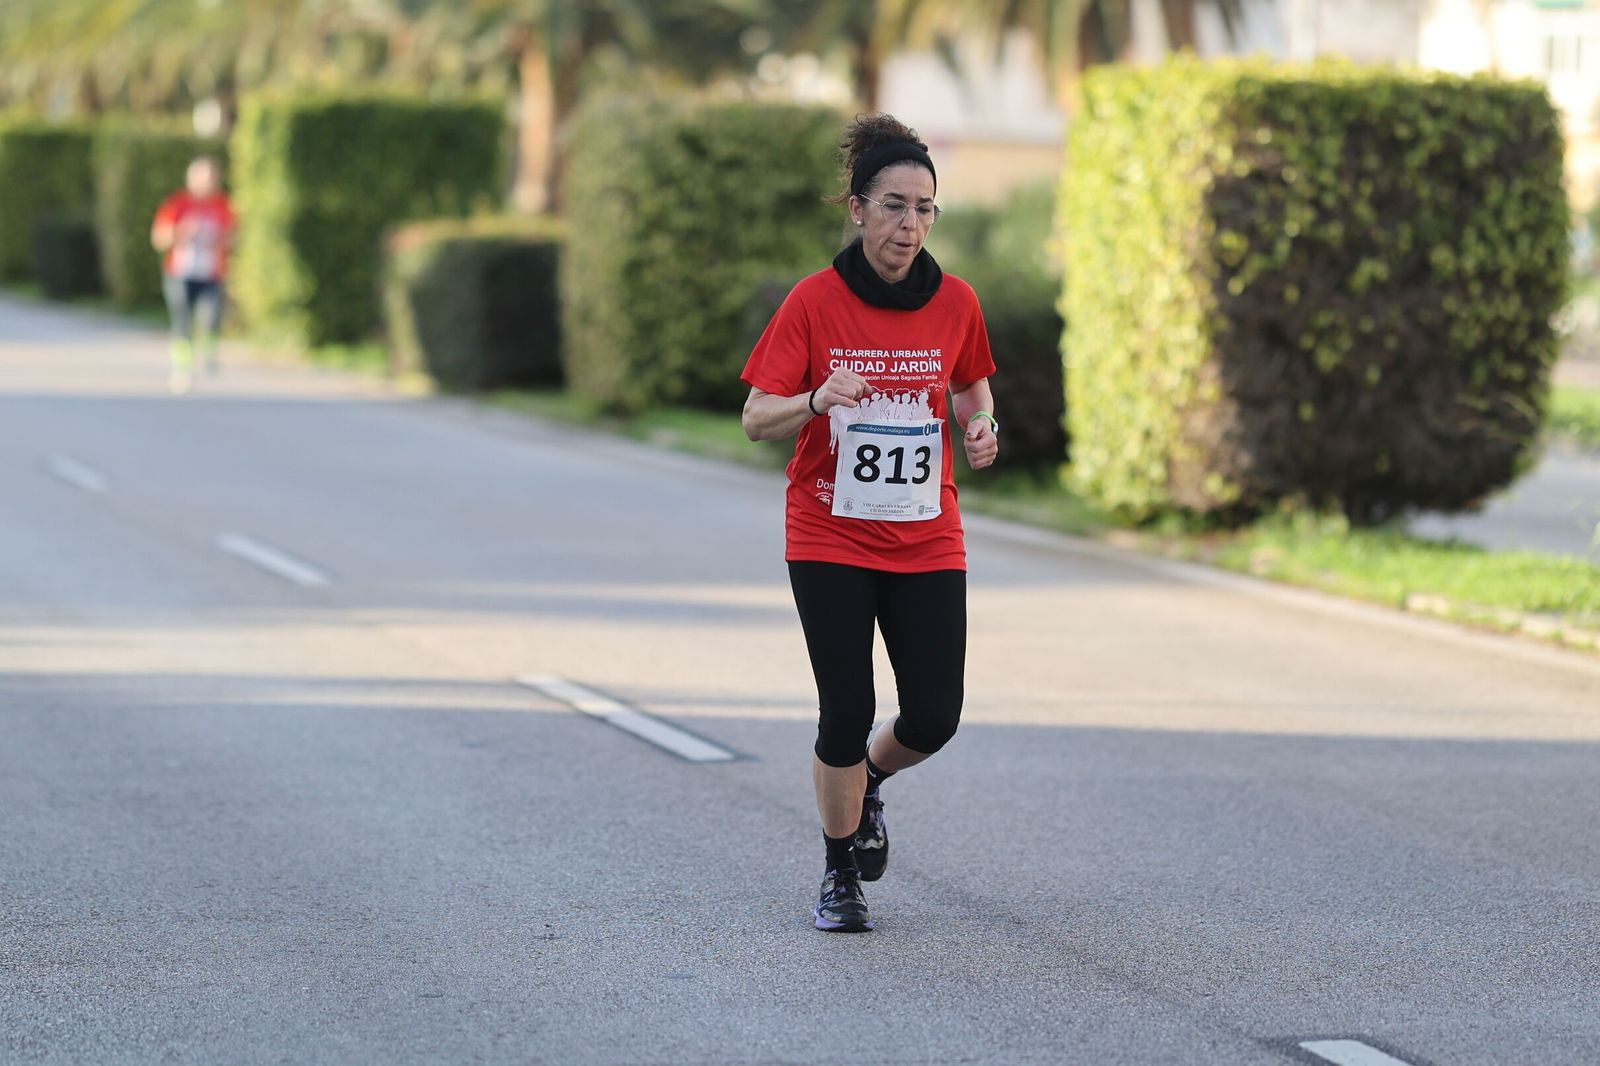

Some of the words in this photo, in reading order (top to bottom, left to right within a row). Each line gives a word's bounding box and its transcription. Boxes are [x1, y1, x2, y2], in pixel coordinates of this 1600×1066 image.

[829, 348, 843, 356] VIII
[845, 349, 890, 358] CARRERA
[830, 359, 886, 372] CIUDAD
[890, 358, 942, 372] JARDÍN
[854, 444, 930, 484] 813
